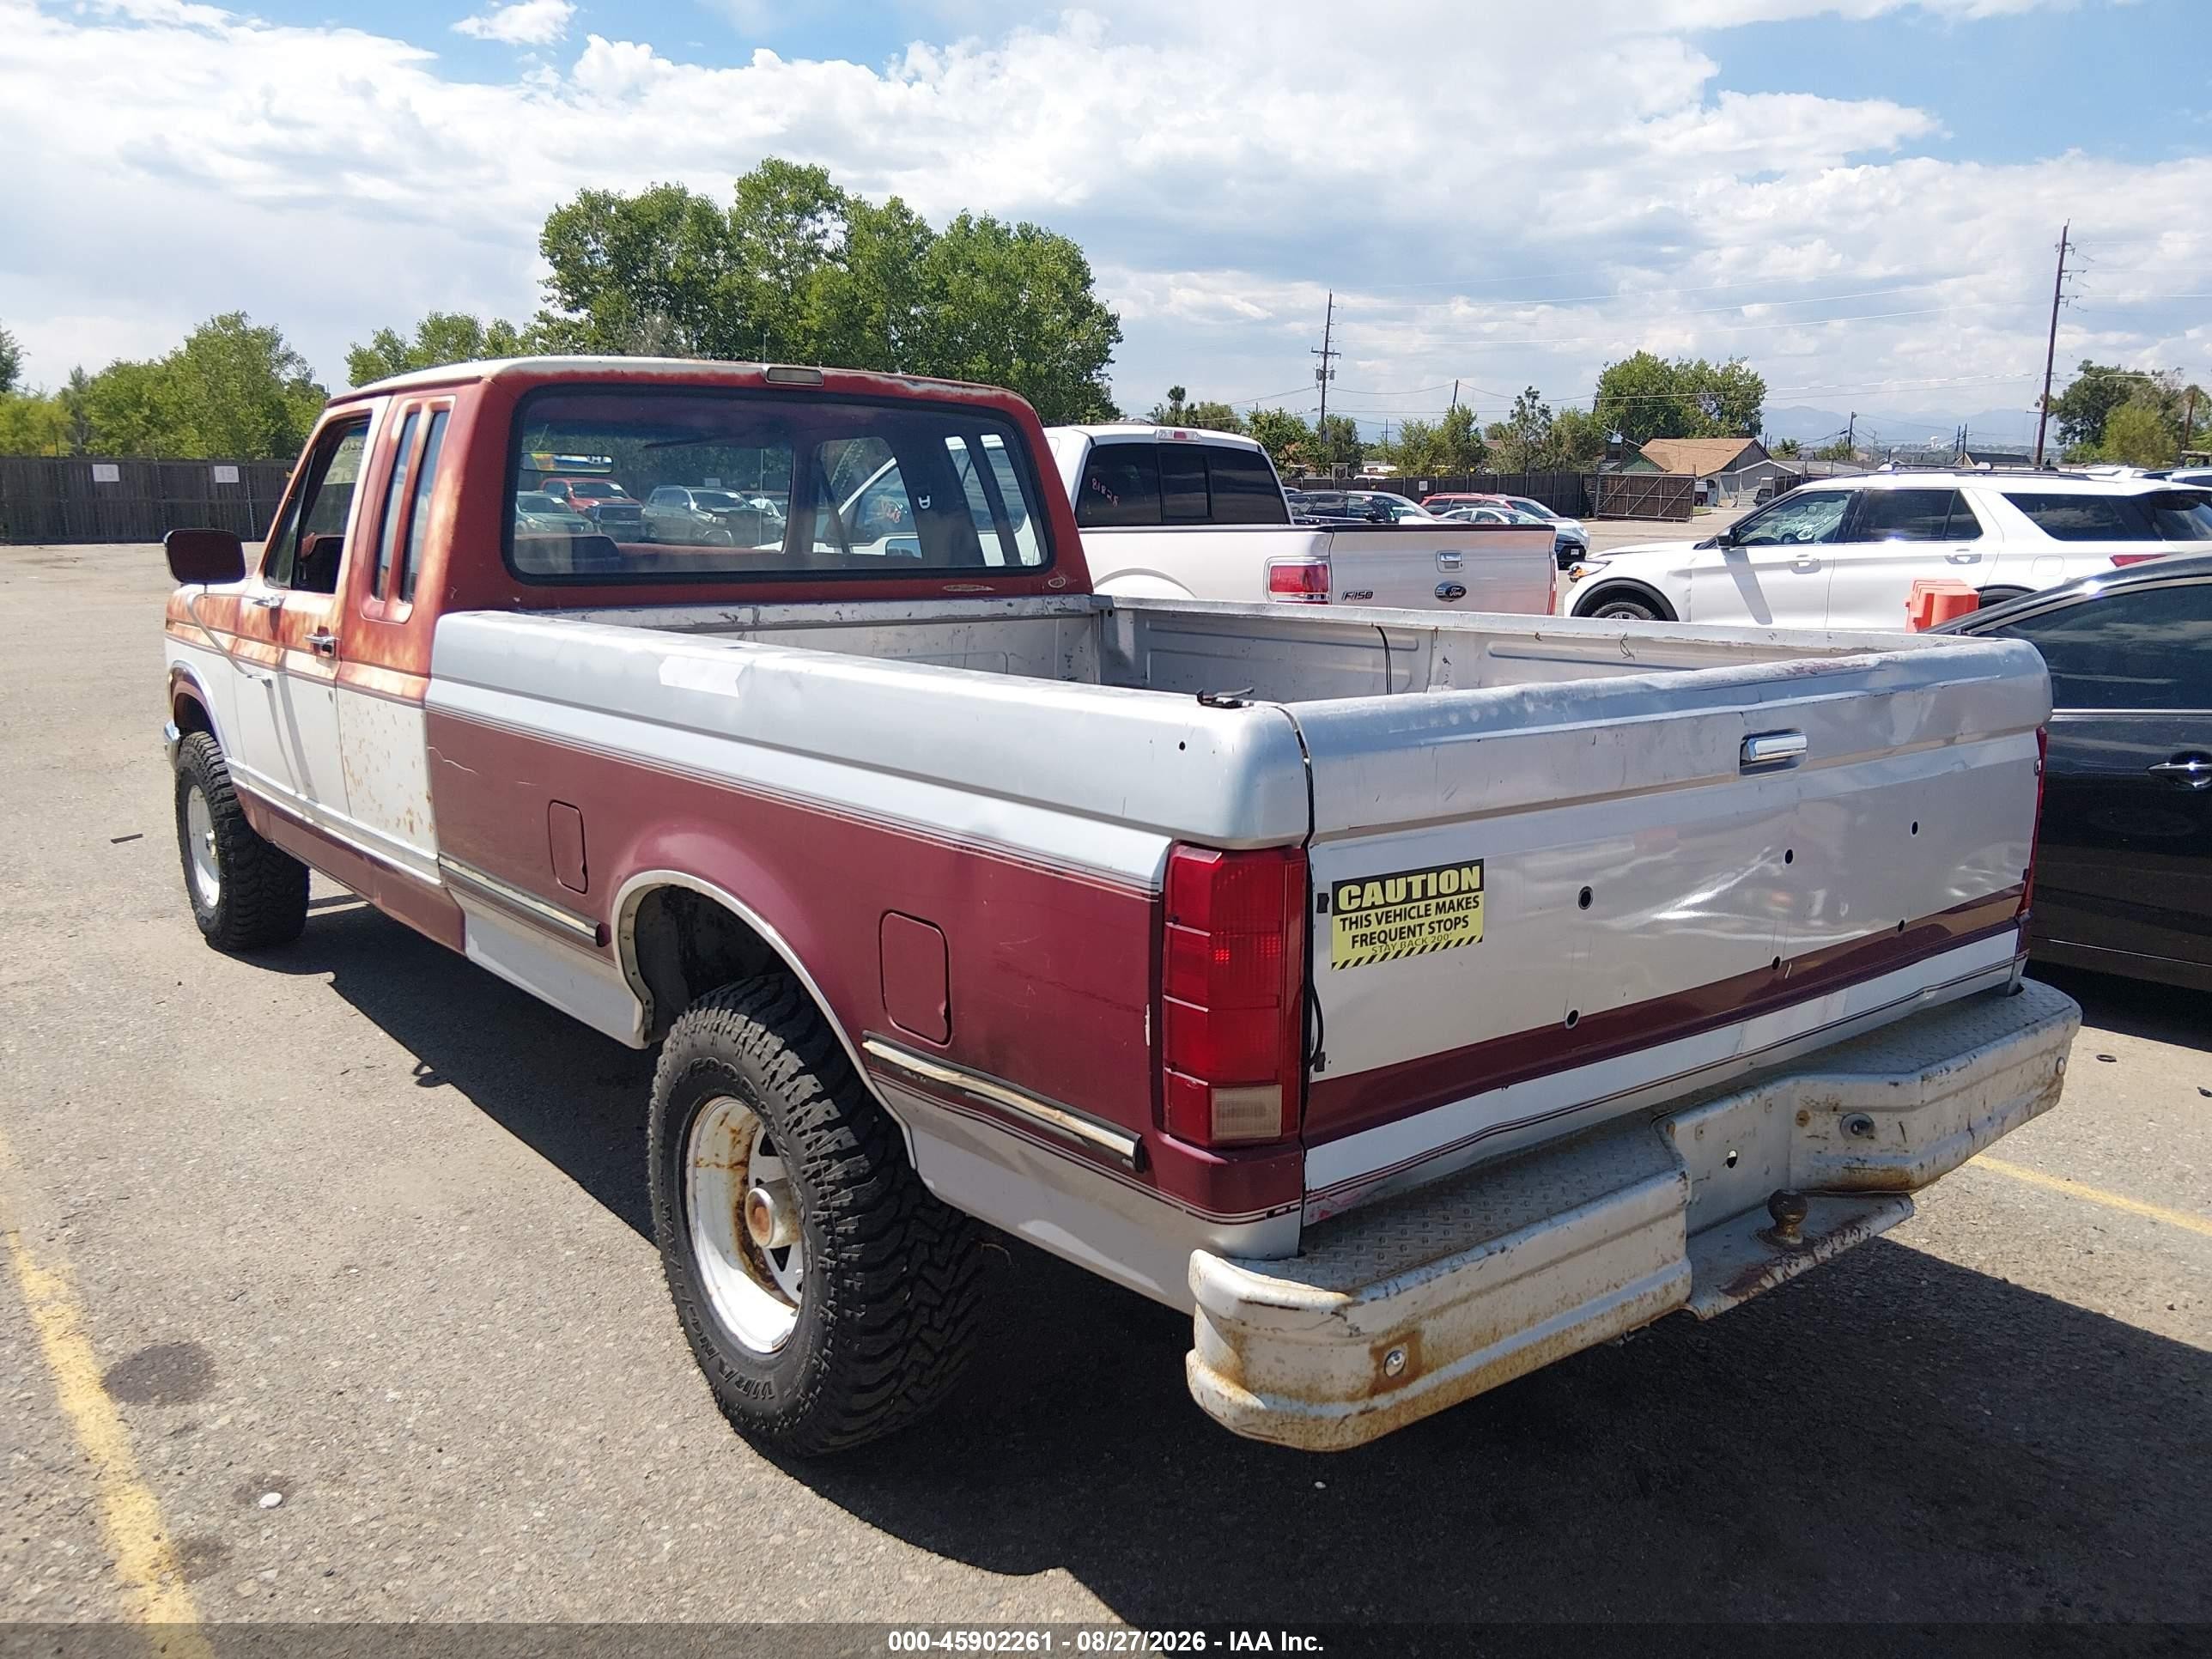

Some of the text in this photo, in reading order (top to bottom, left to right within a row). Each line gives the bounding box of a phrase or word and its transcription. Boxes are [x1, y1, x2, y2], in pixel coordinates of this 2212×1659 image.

[1338, 865, 1481, 911] CAUTION
[1340, 895, 1480, 932] THIS VEHICLE MAKES
[1352, 915, 1469, 949] FREQUENT STOPS
[1371, 943, 1397, 954] STAY
[1400, 936, 1427, 949] BACK
